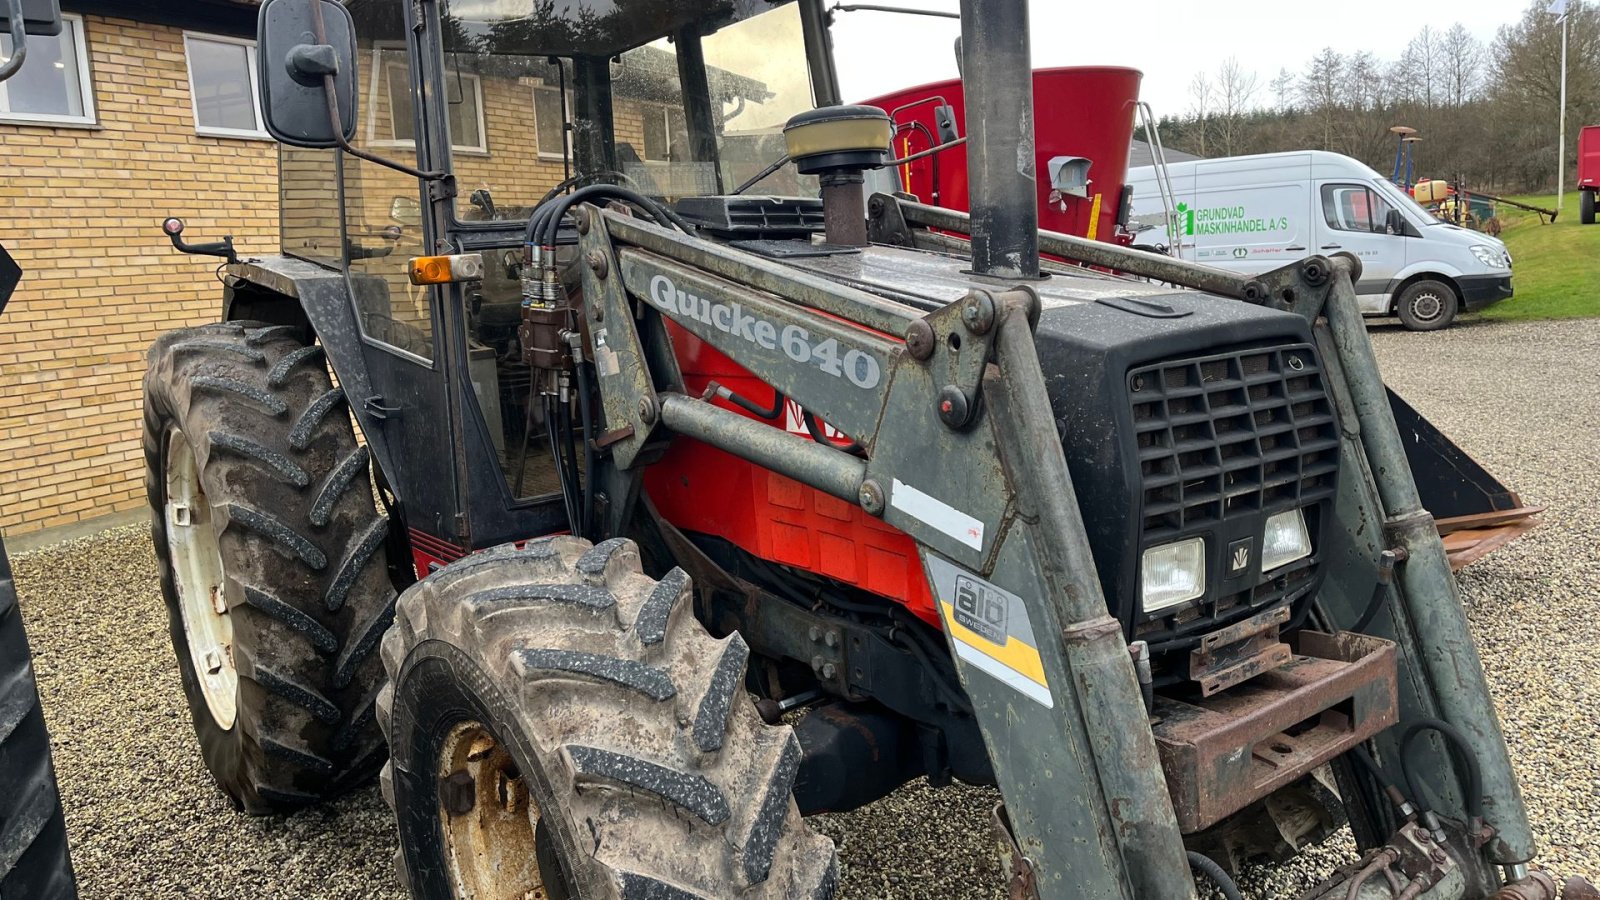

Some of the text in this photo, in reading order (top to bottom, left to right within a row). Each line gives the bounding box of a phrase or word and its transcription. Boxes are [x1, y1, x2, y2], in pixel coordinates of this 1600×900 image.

[1196, 206, 1245, 222] GRUNDVAD
[1196, 216, 1288, 235] MASKINHANDEL A/S
[650, 275, 880, 389] Quicke 640
[959, 614, 1001, 640] SWEDEN
